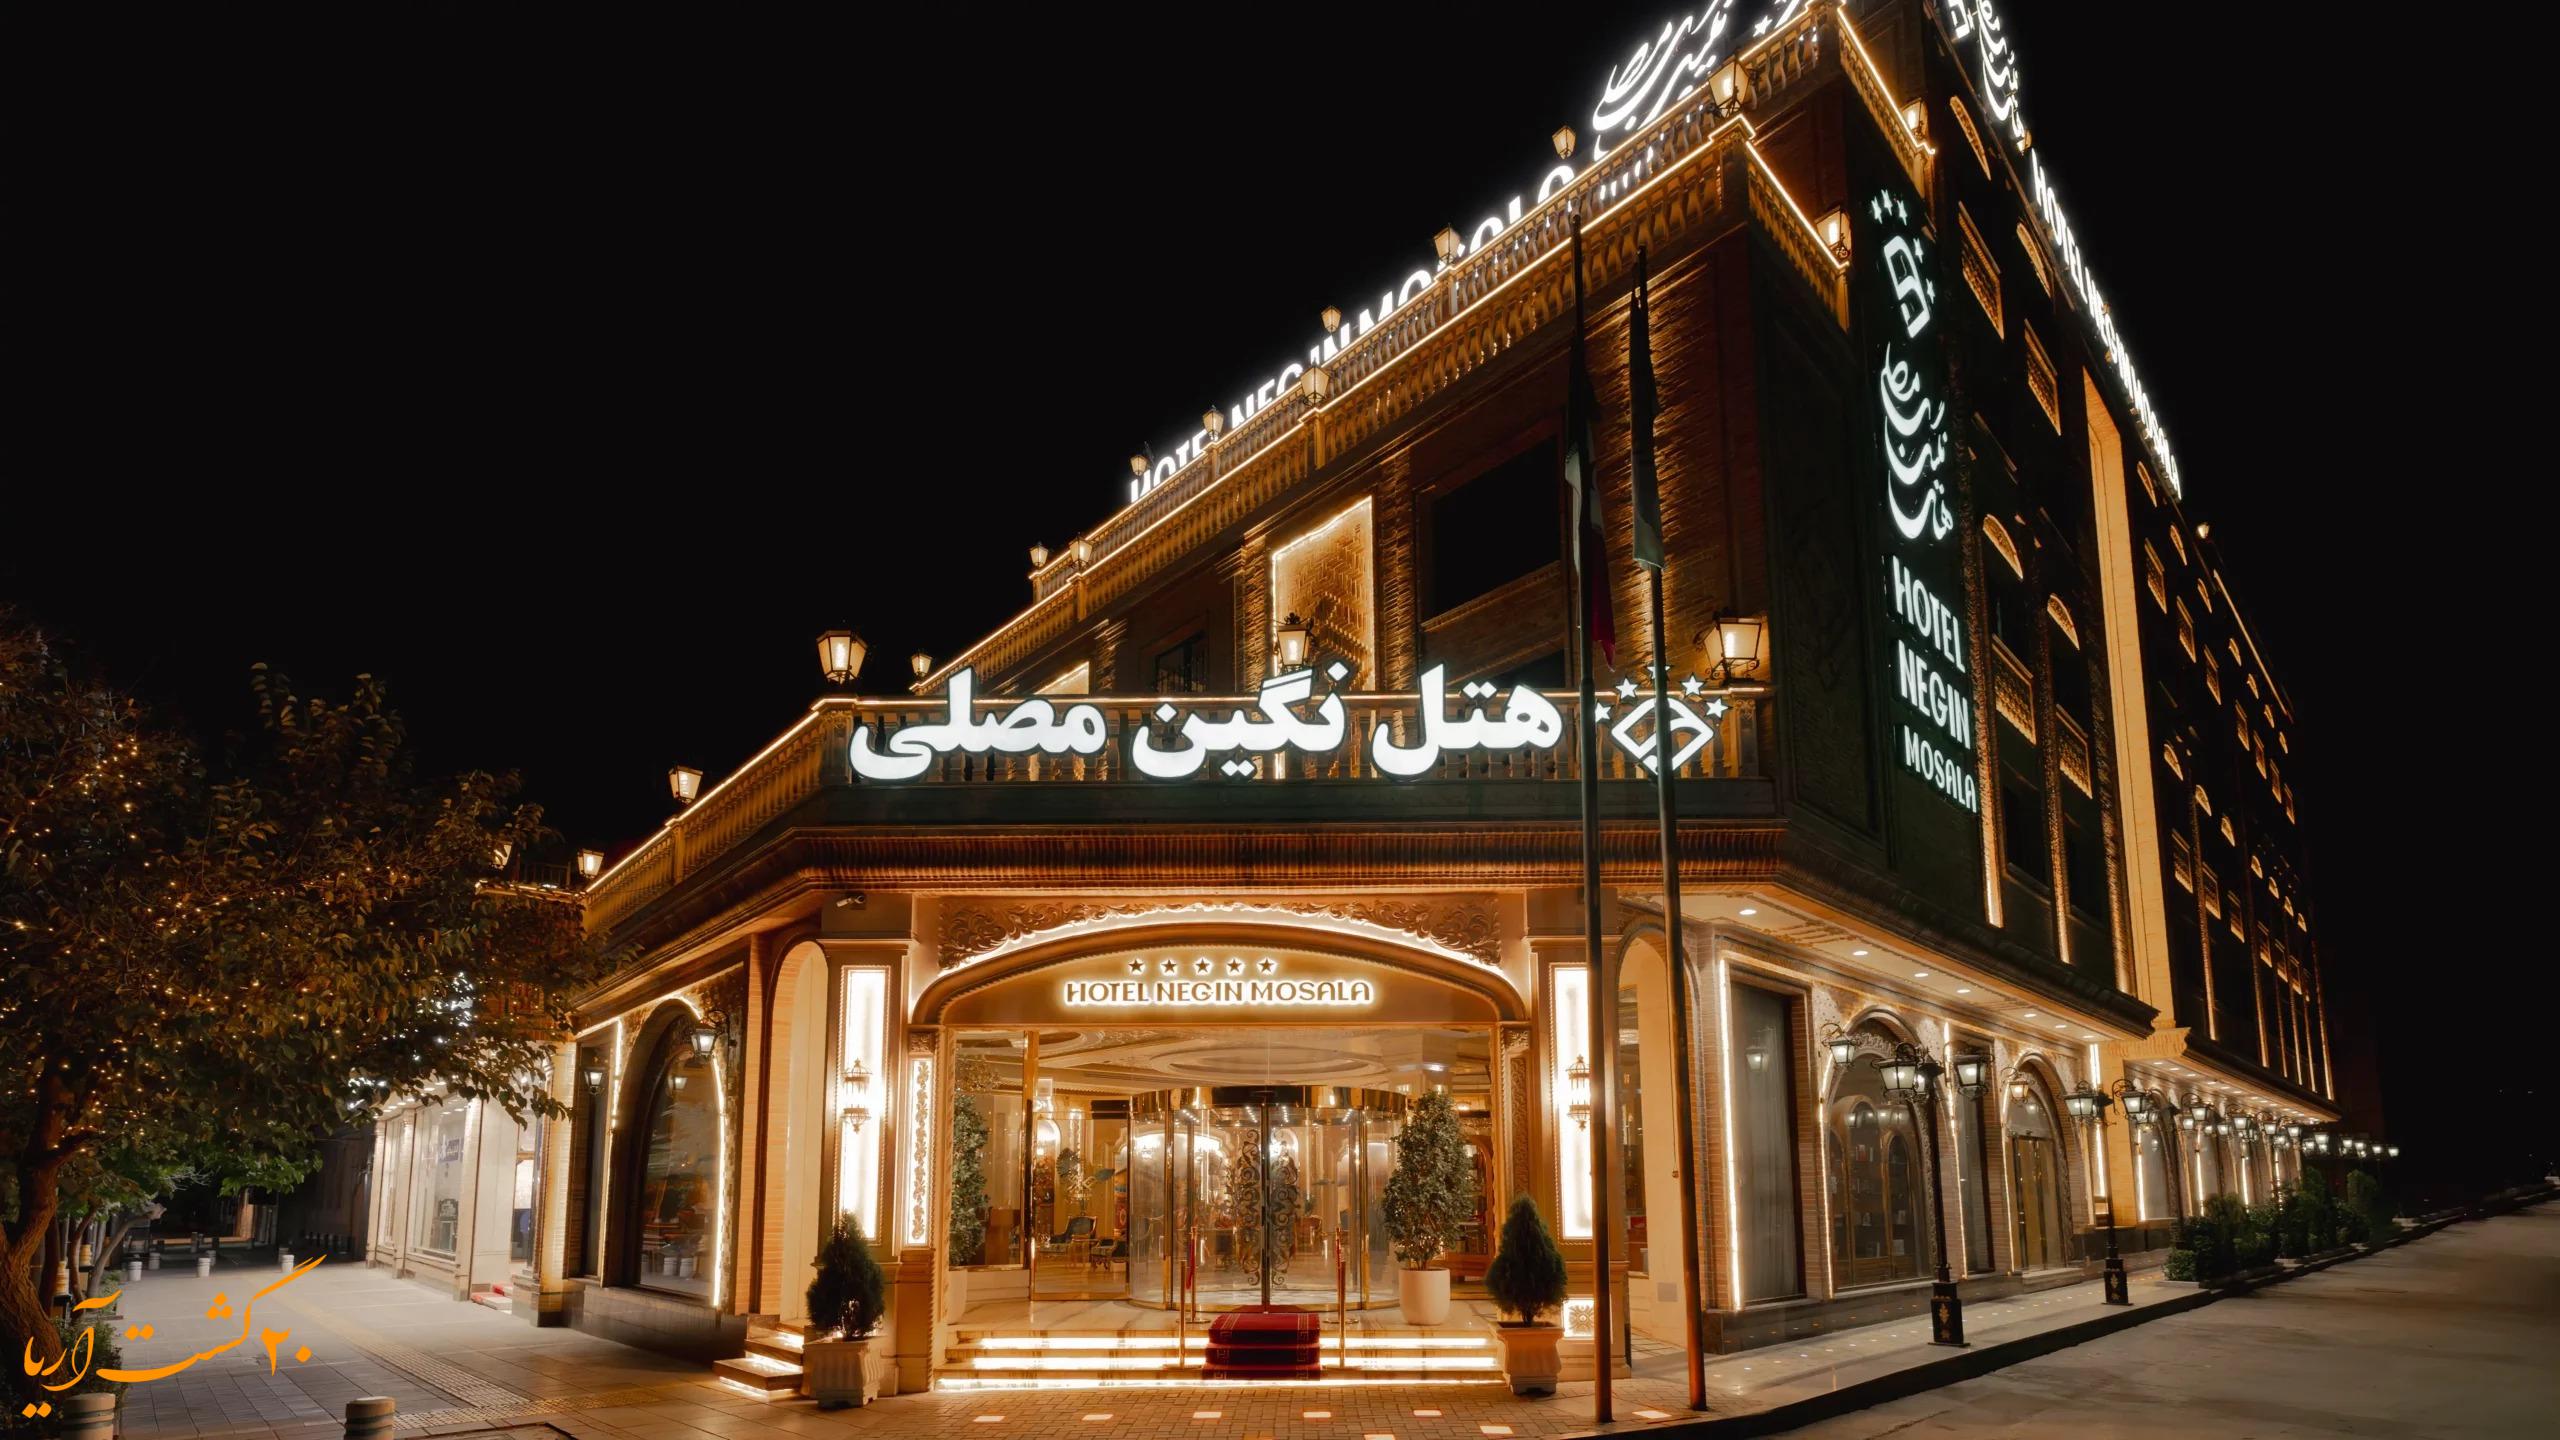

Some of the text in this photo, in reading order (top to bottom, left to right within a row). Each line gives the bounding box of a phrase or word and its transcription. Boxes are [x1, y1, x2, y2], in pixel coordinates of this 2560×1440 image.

[2031, 147, 2089, 305] HOTEL
[1130, 424, 1219, 503] HOTE
[1892, 555, 1966, 673] HOTEL
[849, 661, 1563, 781] هتل نگین مصلی
[1898, 639, 1971, 750] NEGIN
[1904, 724, 1977, 814] MOSALA
[1065, 981, 1371, 1003] HOTEL NEGIN MOSALA
